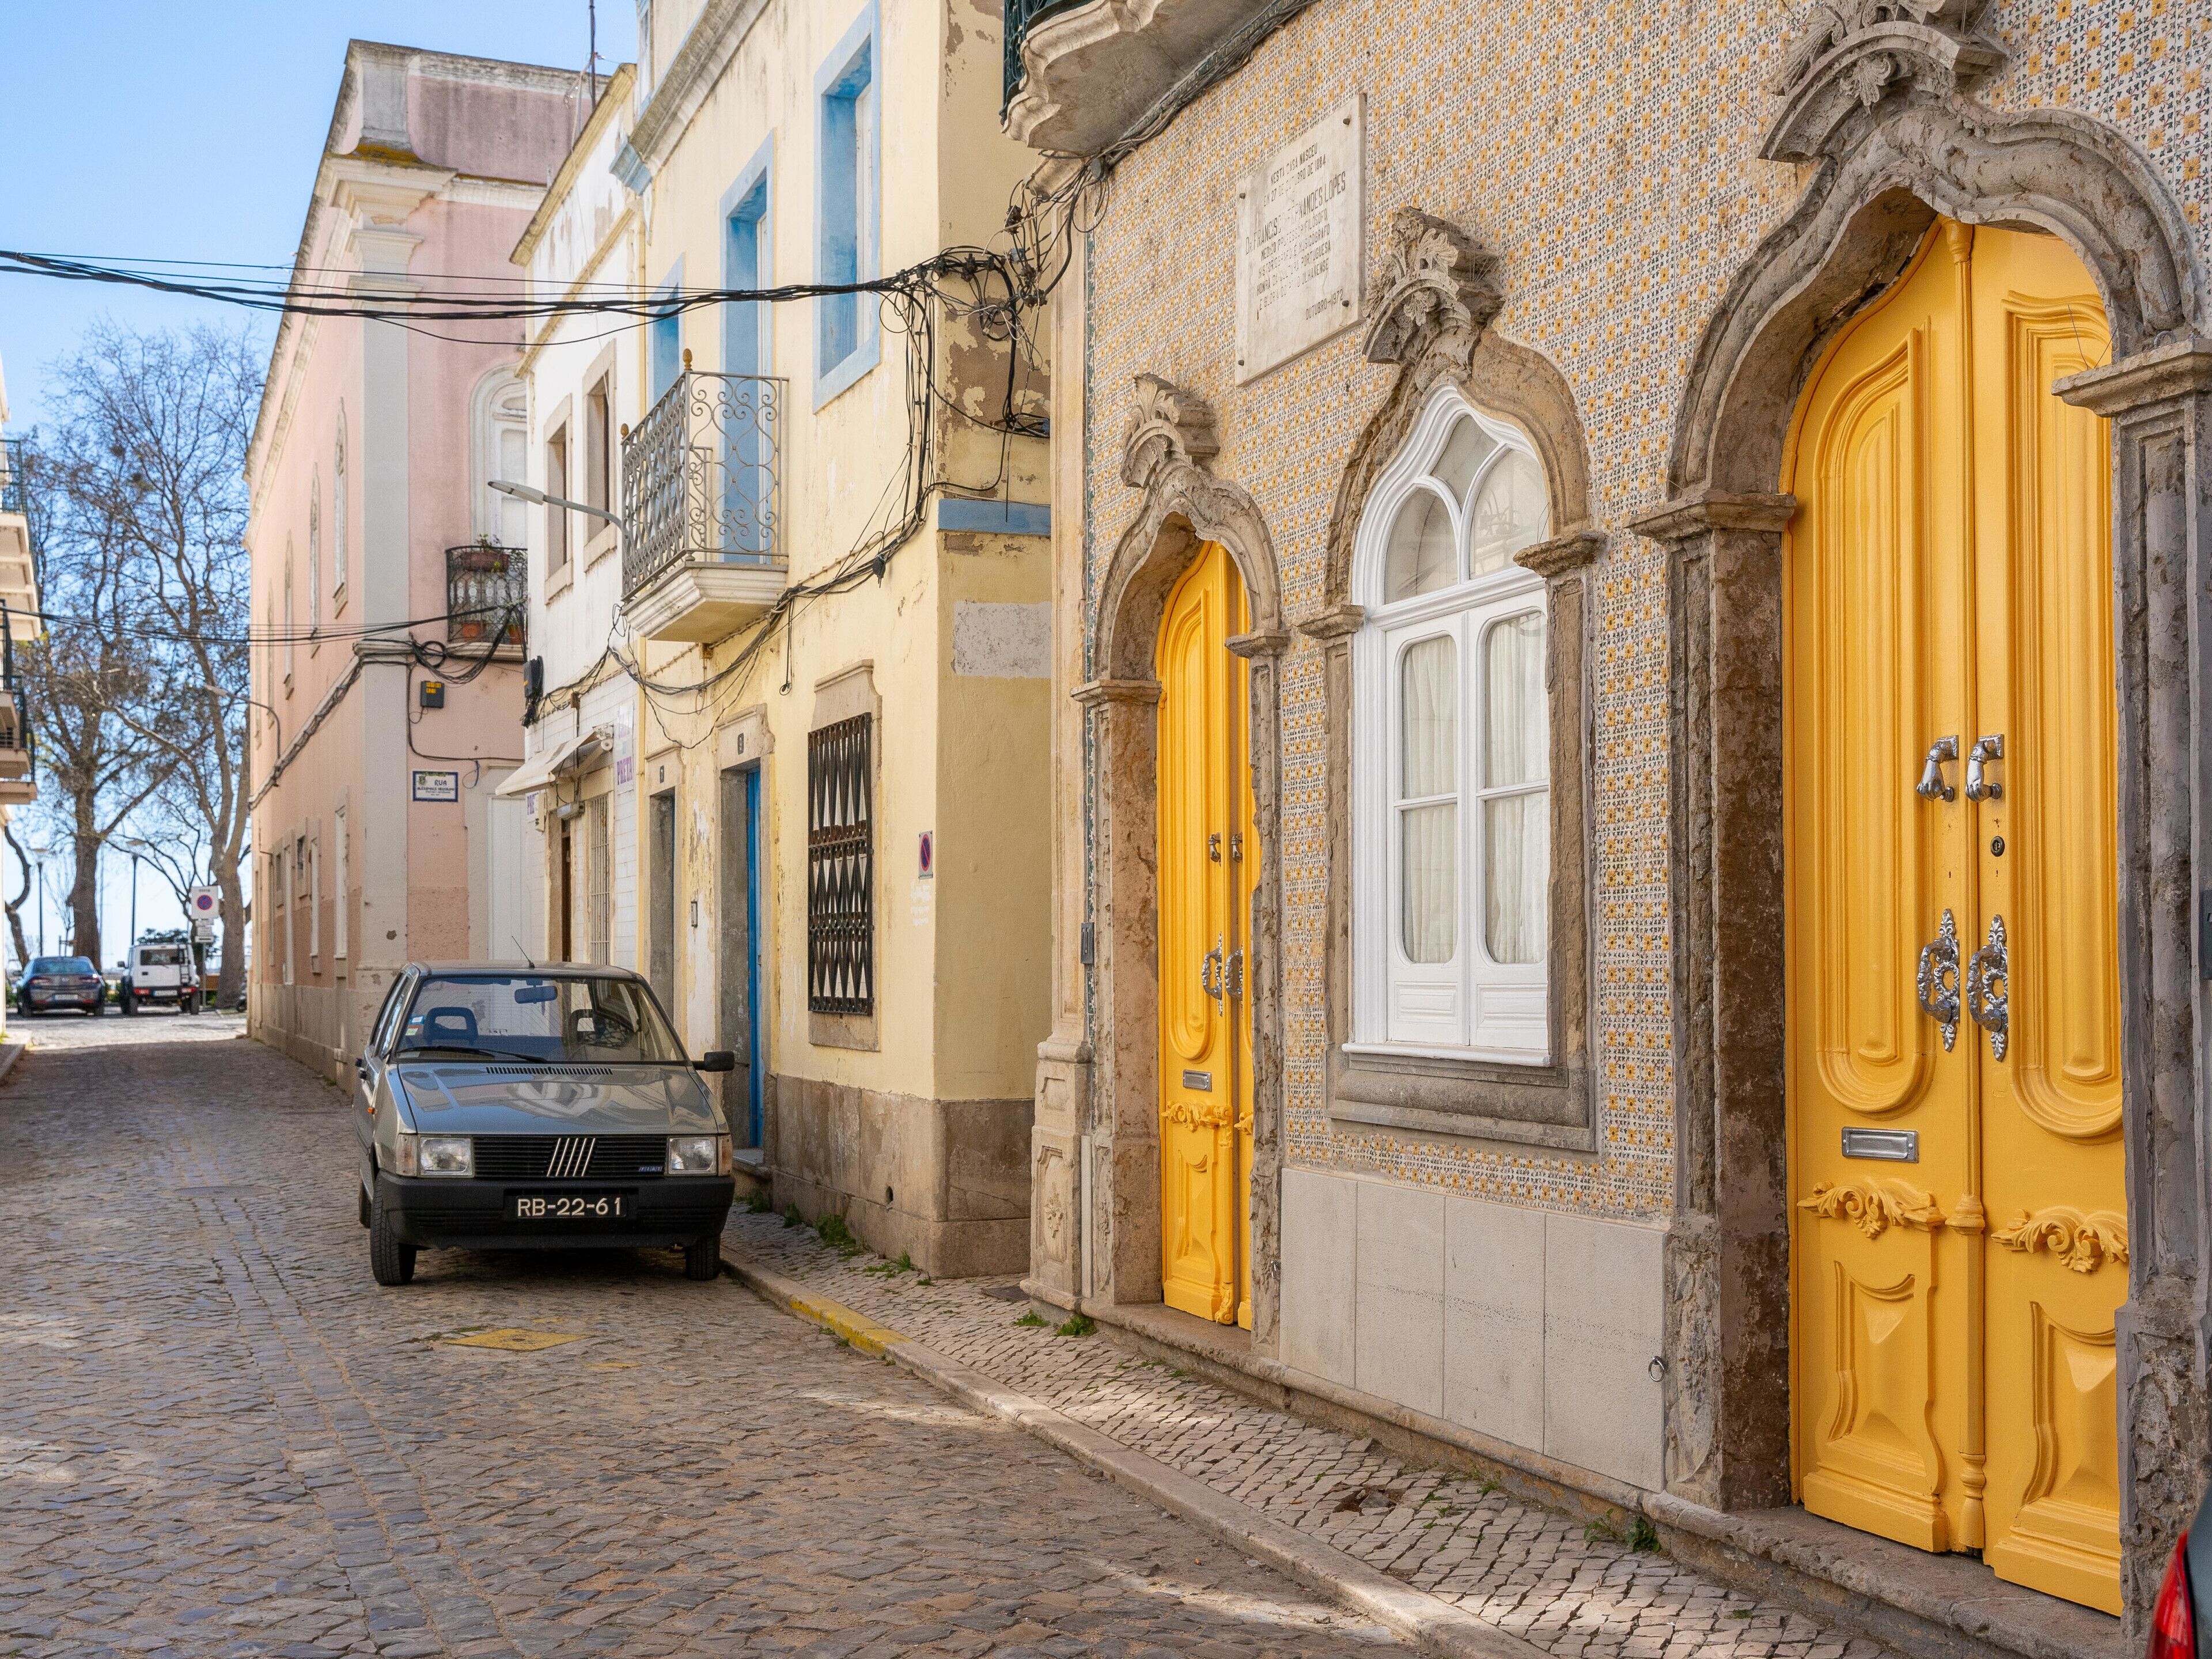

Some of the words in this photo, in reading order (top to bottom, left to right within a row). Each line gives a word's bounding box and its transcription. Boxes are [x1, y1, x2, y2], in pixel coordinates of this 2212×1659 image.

[1270, 165, 1284, 186] NESTA
[1286, 156, 1297, 175] CASA
[1300, 142, 1317, 165] NASCEU
[1271, 187, 1277, 202] 27
[1279, 183, 1283, 197] DE
[1308, 162, 1313, 177] DE
[1315, 153, 1325, 172] 1884
[1253, 211, 1284, 249] FRANCISC
[1324, 170, 1345, 203] LOPES
[1256, 277, 1270, 296] HONRA
[1301, 239, 1331, 268] PORTUGUESA
[1294, 243, 1297, 256] E
[1259, 298, 1262, 310] E
[1302, 257, 1328, 285] OLHANENSE
[617, 756, 633, 785] PRETA
[517, 1197, 622, 1218] RB-22-61
